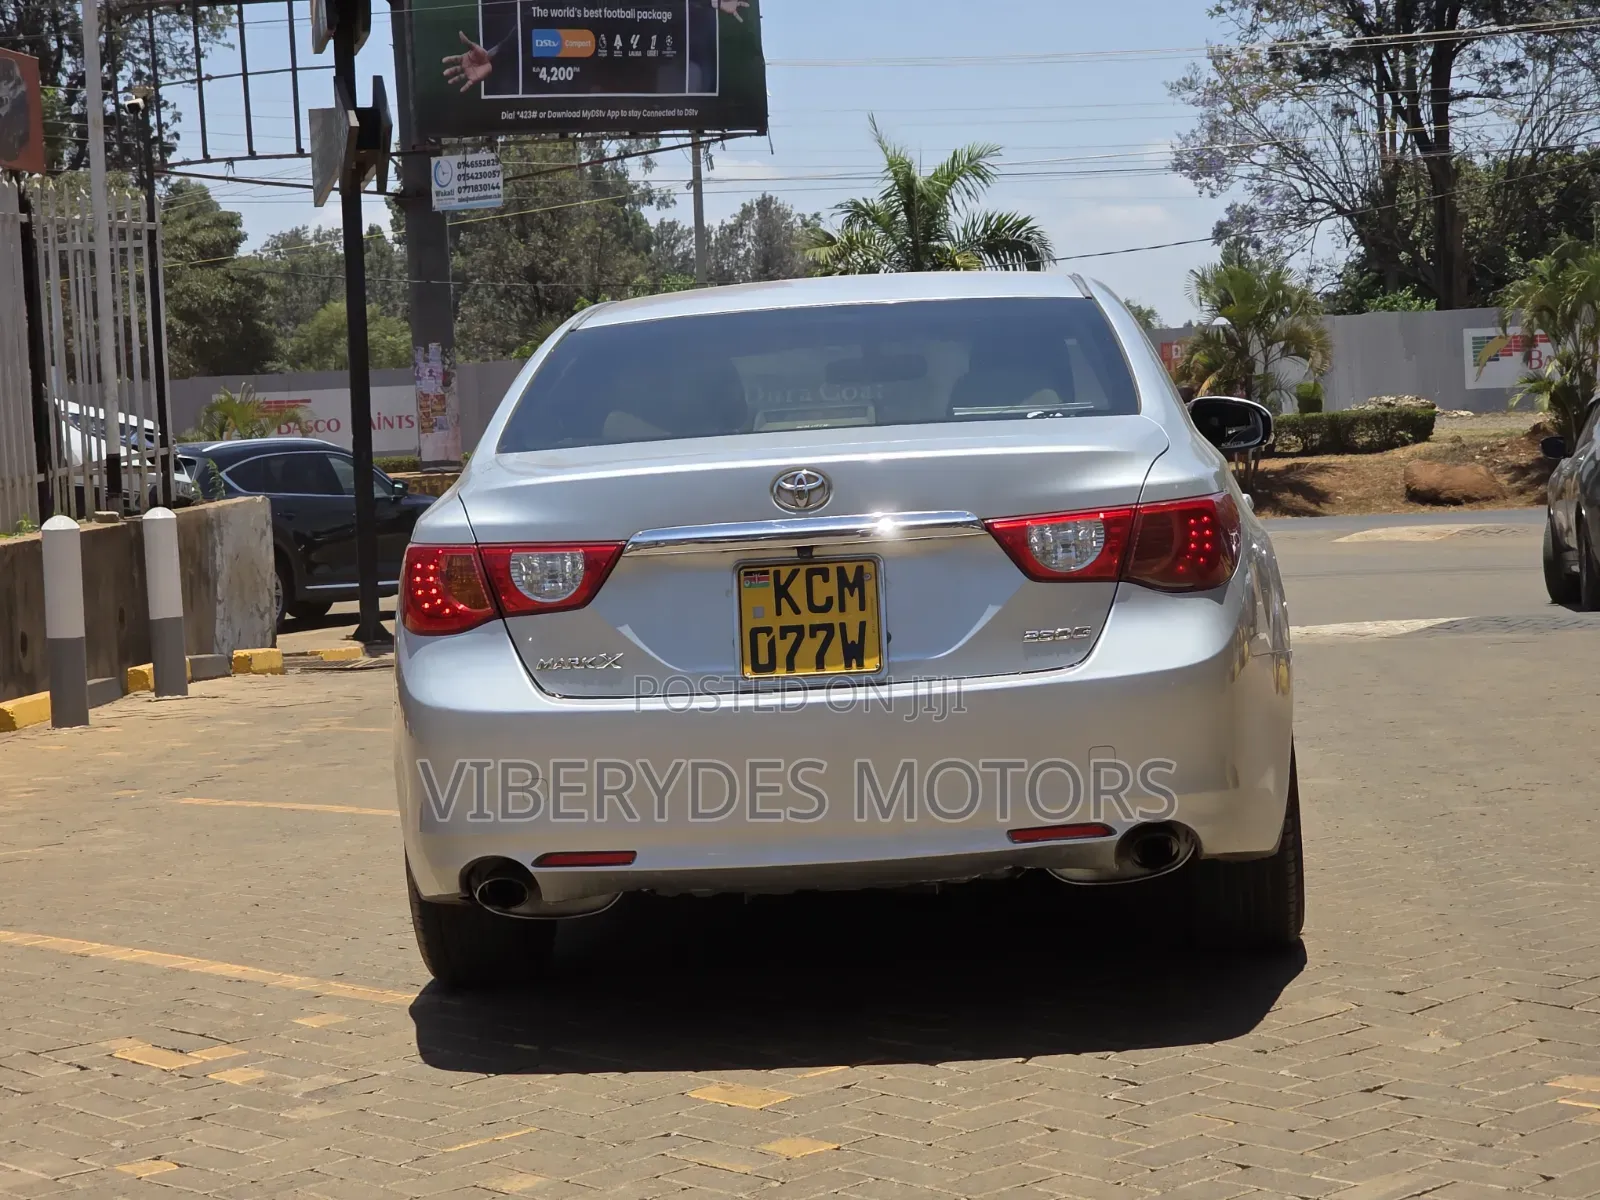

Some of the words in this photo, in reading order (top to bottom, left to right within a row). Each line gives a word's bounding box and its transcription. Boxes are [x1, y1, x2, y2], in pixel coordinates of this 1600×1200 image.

[532, 6, 549, 18] The
[550, 6, 582, 18] world's
[583, 7, 602, 18] best
[604, 7, 636, 19] football
[637, 10, 672, 23] package
[535, 39, 559, 47] DStv
[565, 40, 591, 48] Compact
[539, 66, 574, 83] 4,200
[501, 111, 516, 120] Dial
[538, 111, 547, 119] or
[547, 110, 581, 119] Download
[581, 109, 606, 120] MyDStv
[606, 109, 620, 120] App
[620, 109, 628, 117] to
[628, 109, 642, 120] stay
[642, 108, 676, 117] Connected
[676, 108, 684, 116] to
[684, 108, 699, 117] DStv
[773, 565, 866, 616] KCM
[749, 621, 867, 673] 077W
[536, 656, 597, 670] MARK
[596, 652, 624, 670] X
